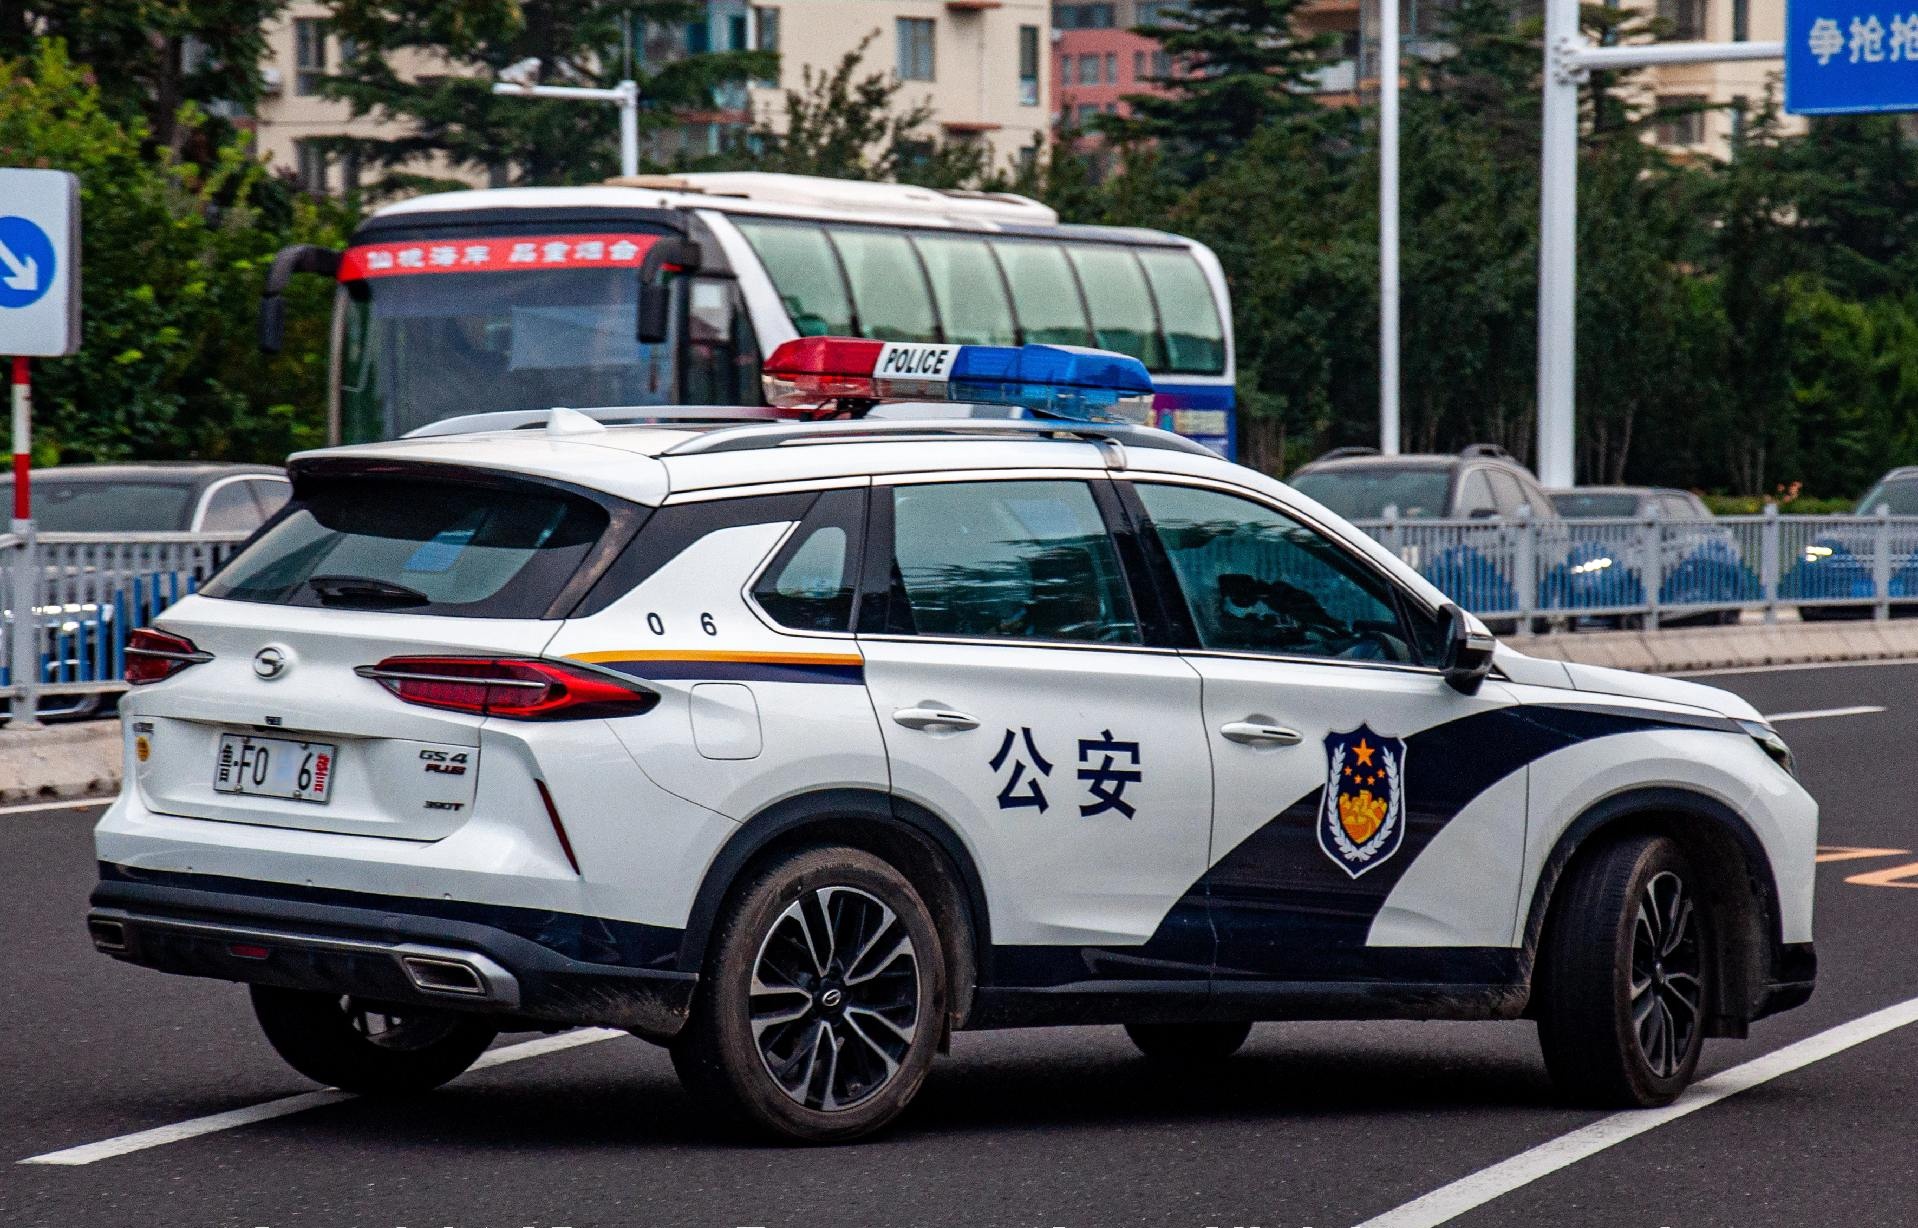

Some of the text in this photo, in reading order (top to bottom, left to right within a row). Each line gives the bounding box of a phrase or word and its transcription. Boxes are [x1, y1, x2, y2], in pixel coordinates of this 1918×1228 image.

[883, 348, 949, 375] POLICE
[424, 763, 467, 776] PLUS
[988, 726, 1142, 821] 公安
